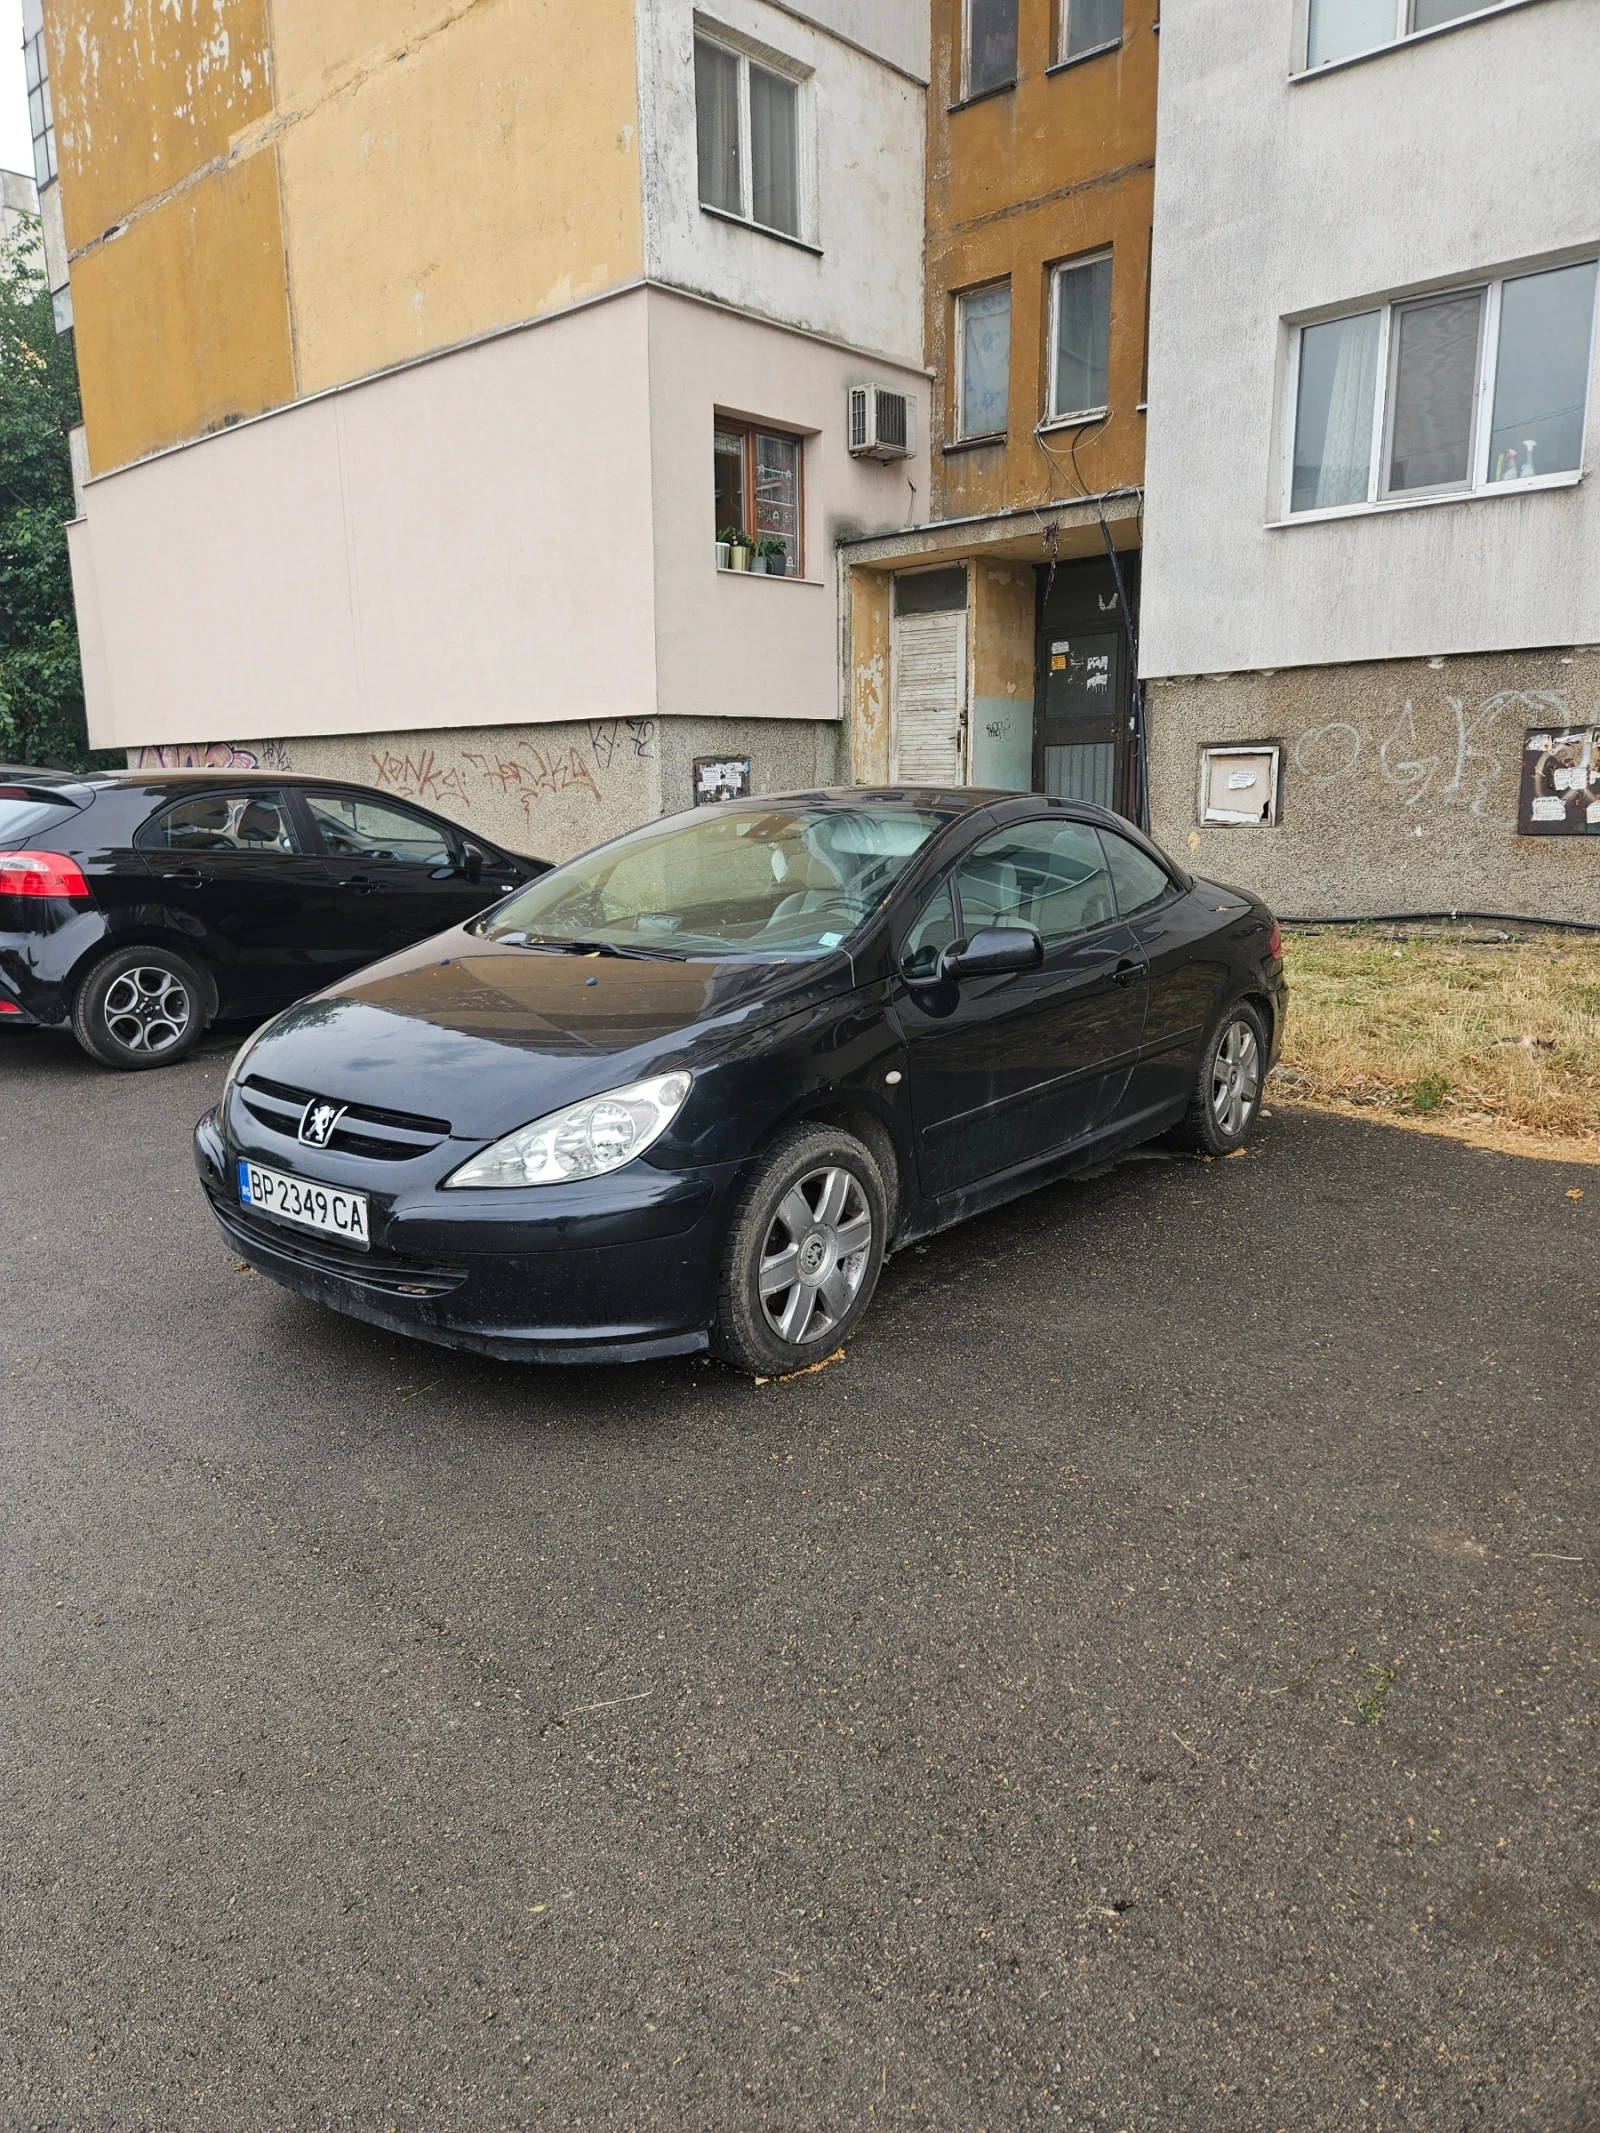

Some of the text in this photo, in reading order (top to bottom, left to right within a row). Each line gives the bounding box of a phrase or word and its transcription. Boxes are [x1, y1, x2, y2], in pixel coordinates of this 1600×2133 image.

[251, 1170, 364, 1235] BP 2349 CA
